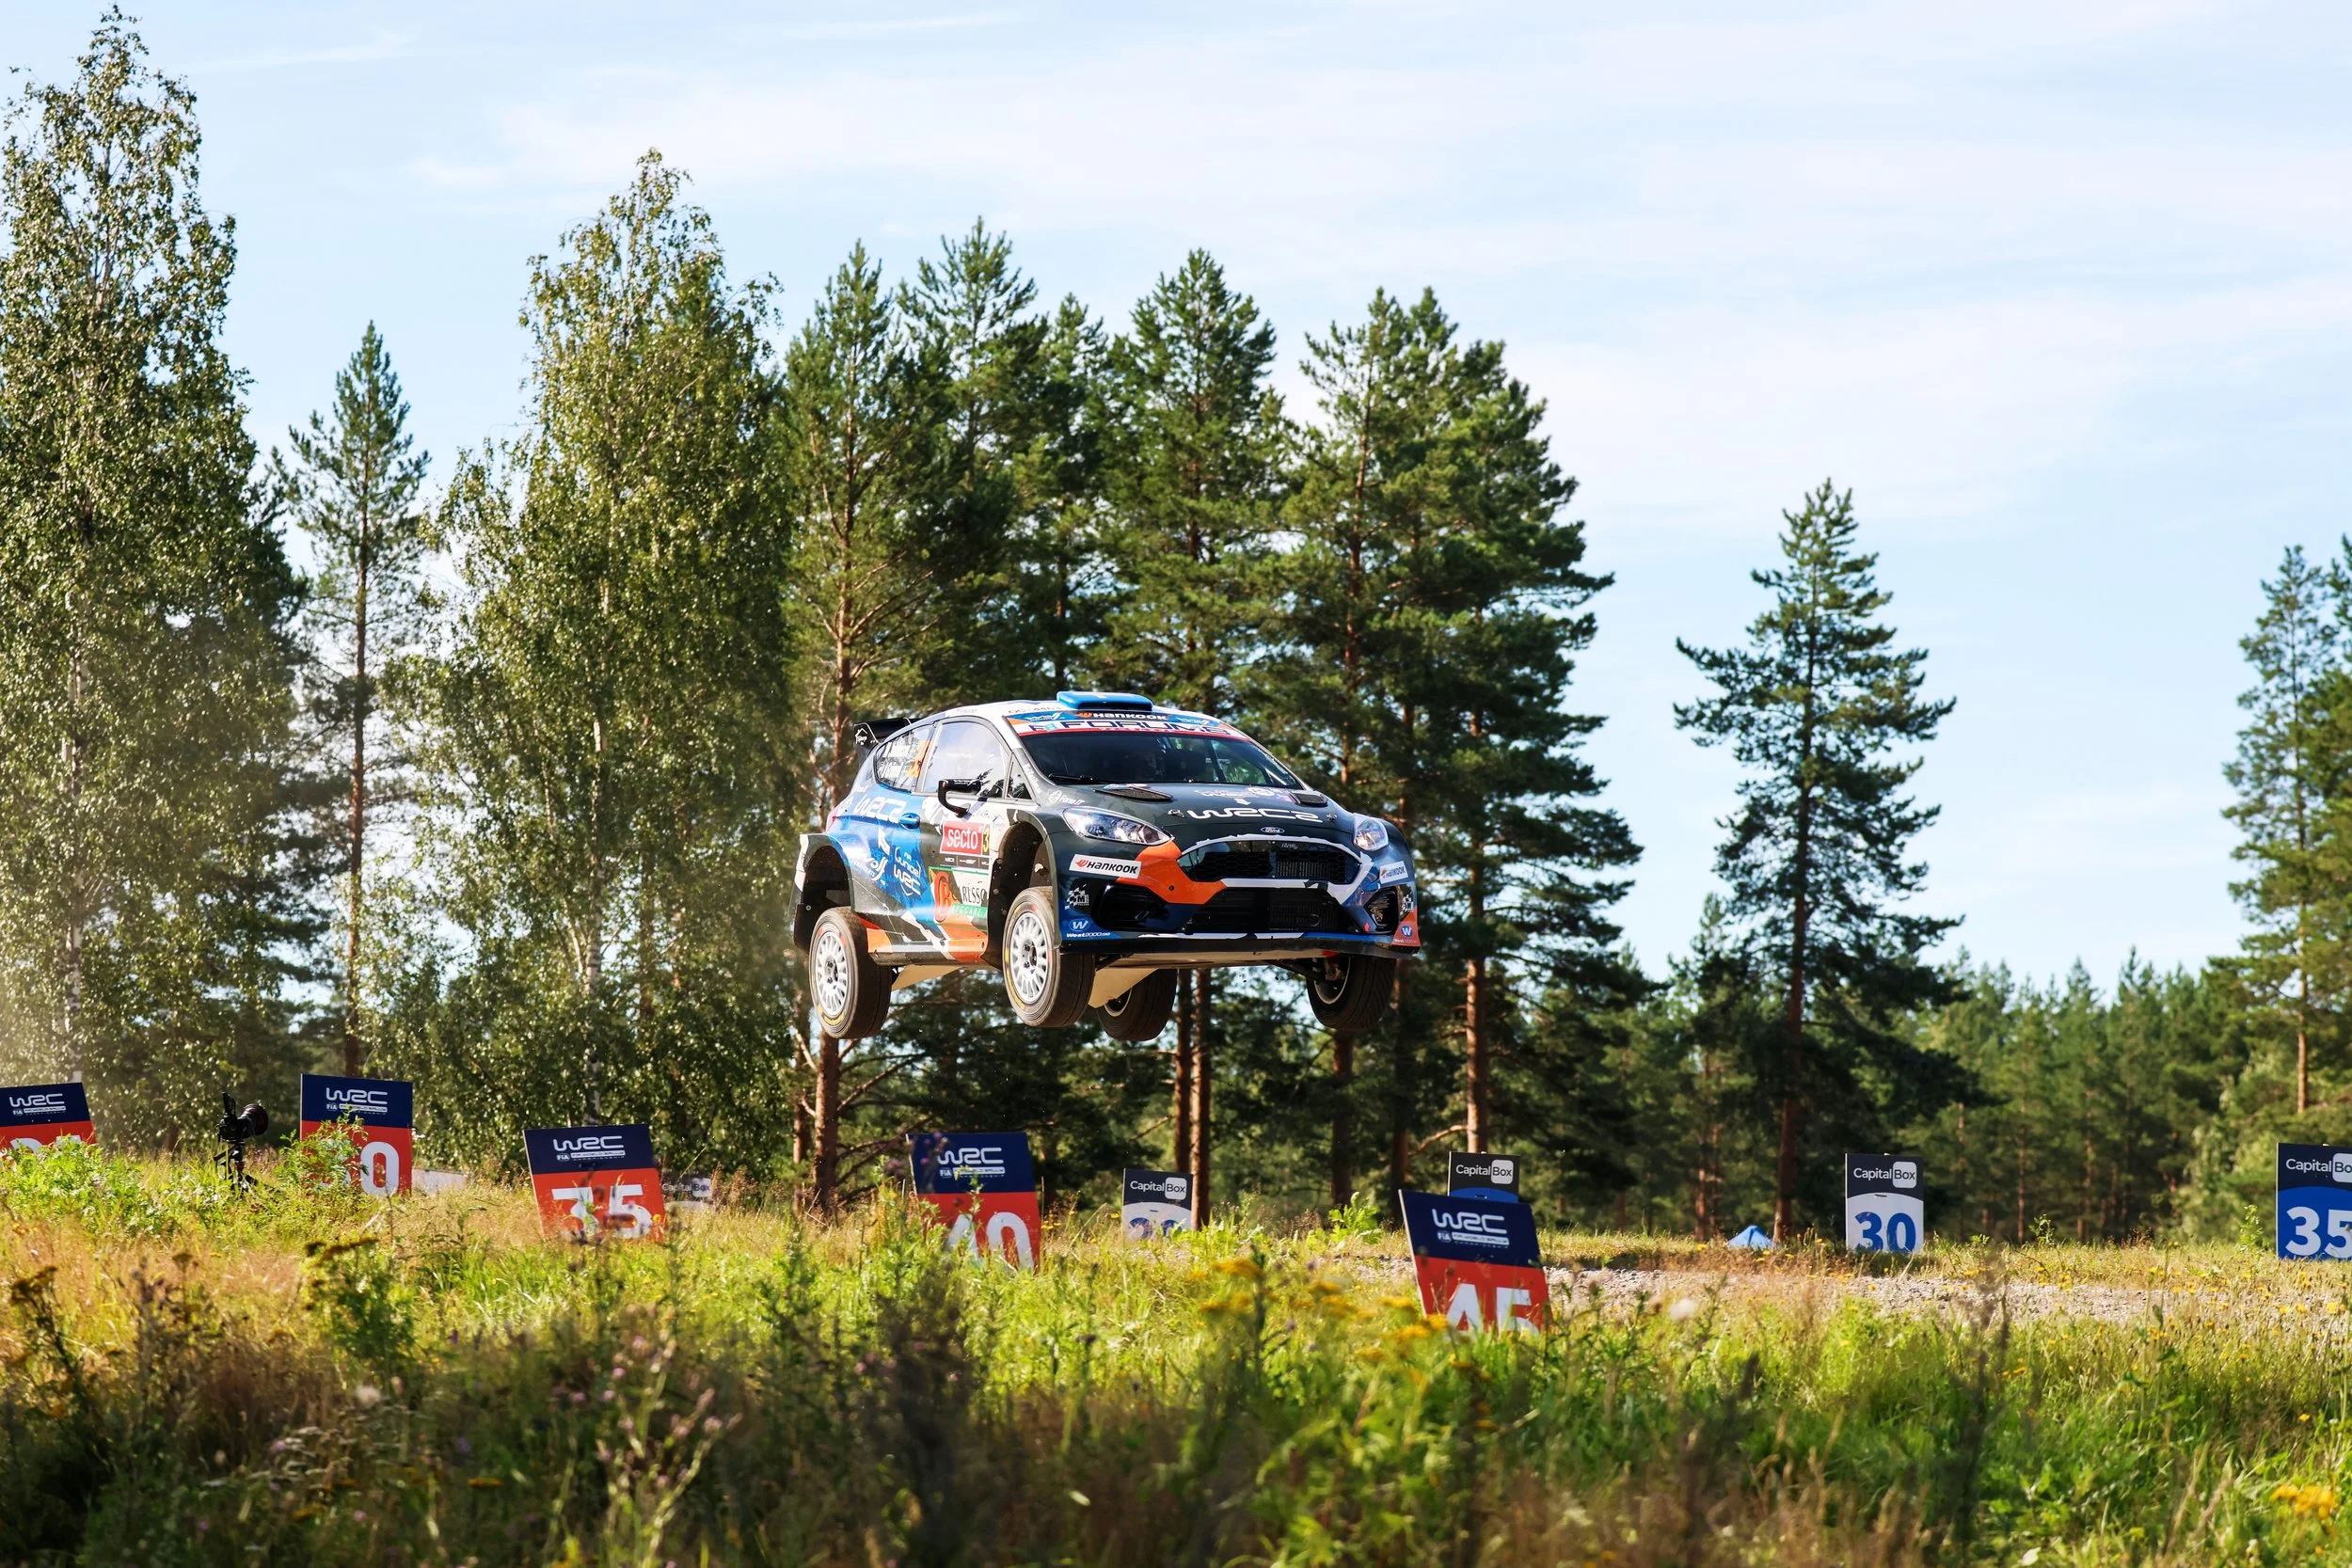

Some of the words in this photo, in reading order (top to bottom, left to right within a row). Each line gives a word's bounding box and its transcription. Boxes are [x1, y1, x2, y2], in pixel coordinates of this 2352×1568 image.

[1186, 808, 1324, 823] WRC2
[946, 828, 978, 850] secto
[1073, 920, 1089, 929] W
[9, 1093, 65, 1108] WRC
[326, 1086, 388, 1104] WRC
[552, 1135, 625, 1152] WRC
[937, 1147, 1005, 1165] WRC
[551, 1183, 653, 1238] 35
[1432, 1208, 1507, 1234] WRC
[1854, 1211, 1916, 1255] 30
[2285, 1206, 2352, 1259] 35
